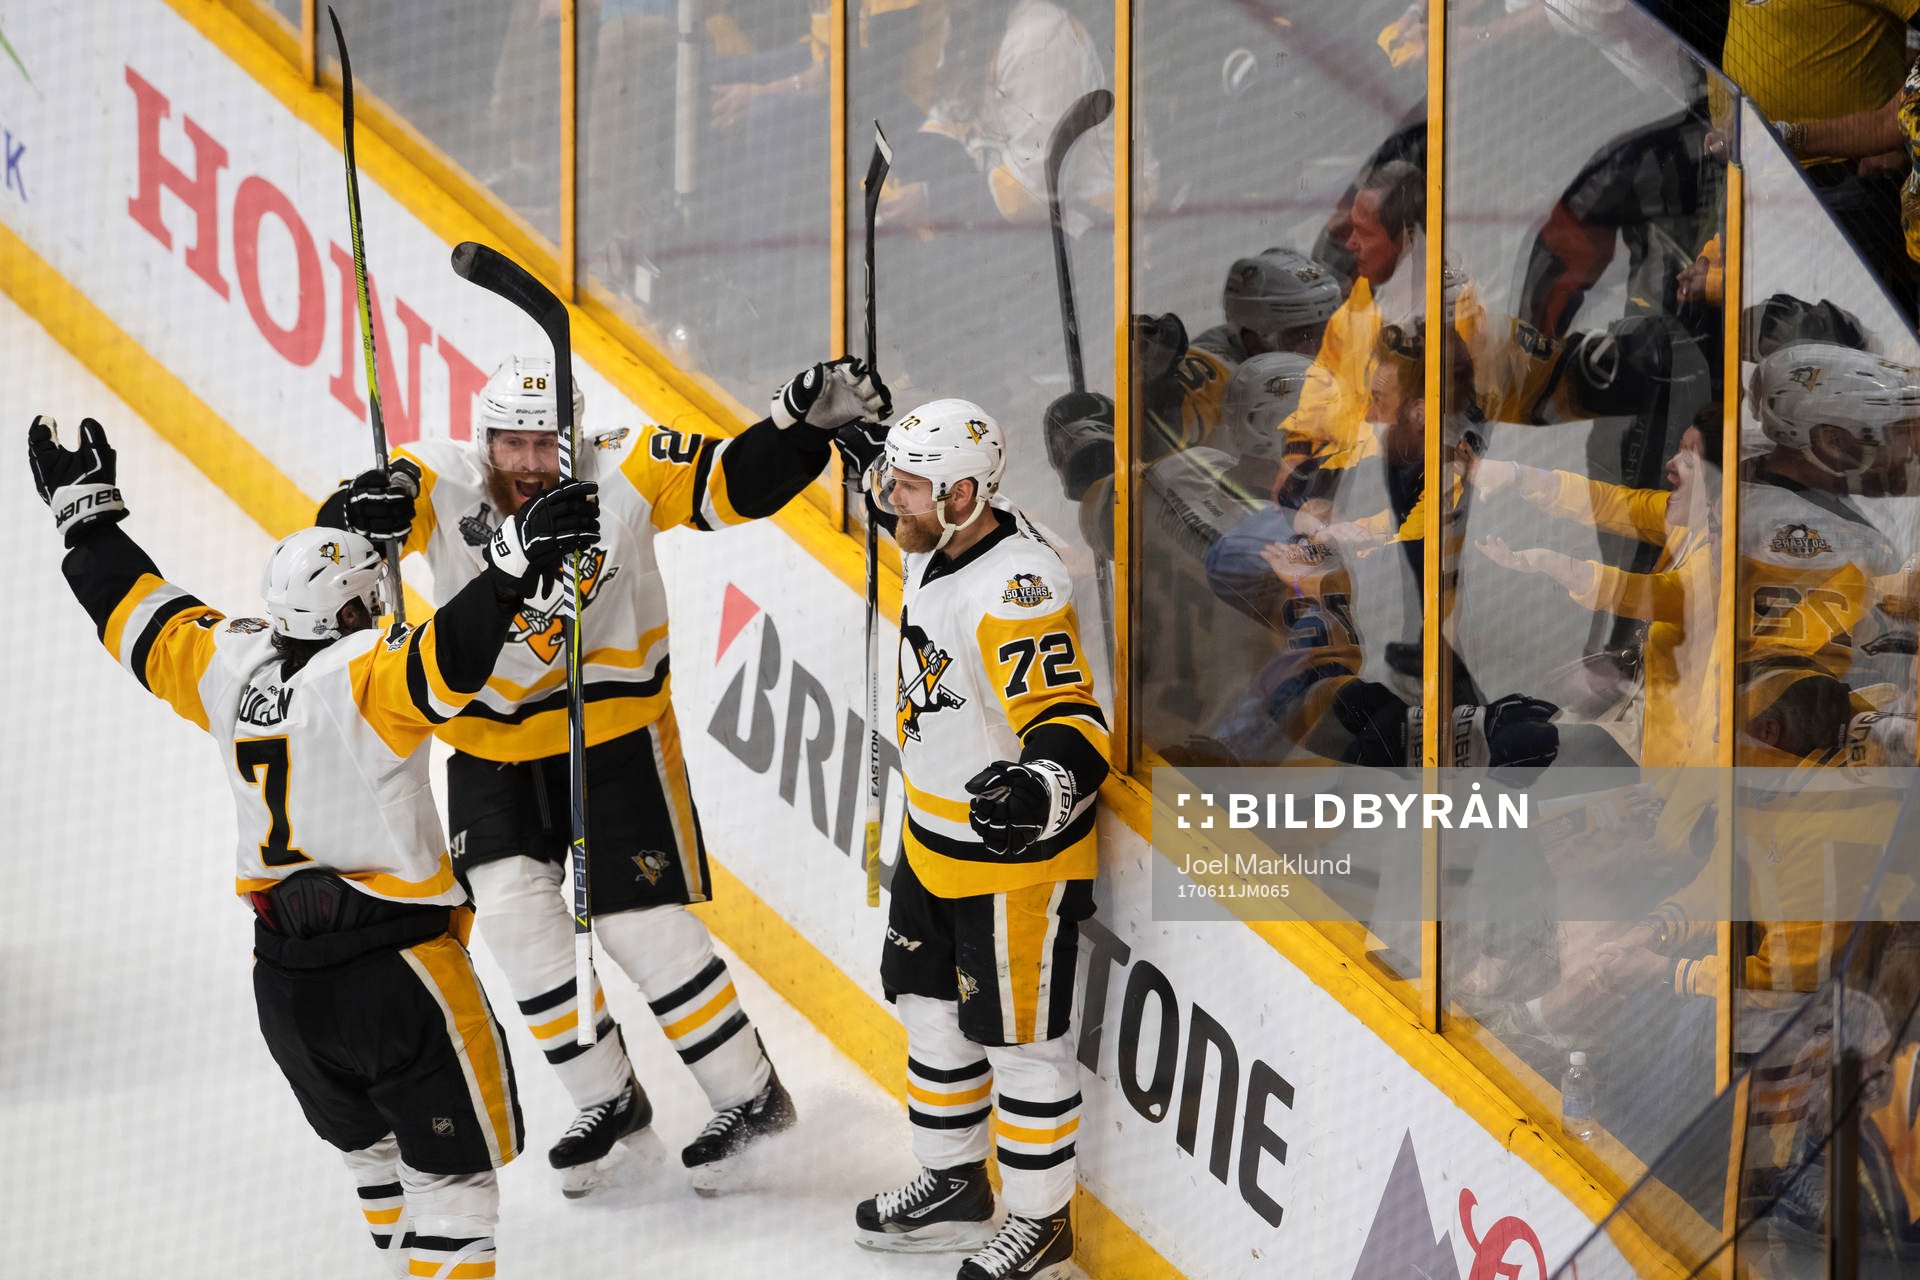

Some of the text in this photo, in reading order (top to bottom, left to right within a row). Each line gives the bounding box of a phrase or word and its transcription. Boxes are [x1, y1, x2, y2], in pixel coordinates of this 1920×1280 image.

[522, 376, 548, 390] 28
[56, 487, 121, 529] BAUER
[1006, 587, 1048, 598] 50 YEARS
[998, 630, 1084, 700] 72
[871, 729, 879, 798] EASTON
[234, 734, 313, 868] 7
[573, 837, 589, 928] ALPHA
